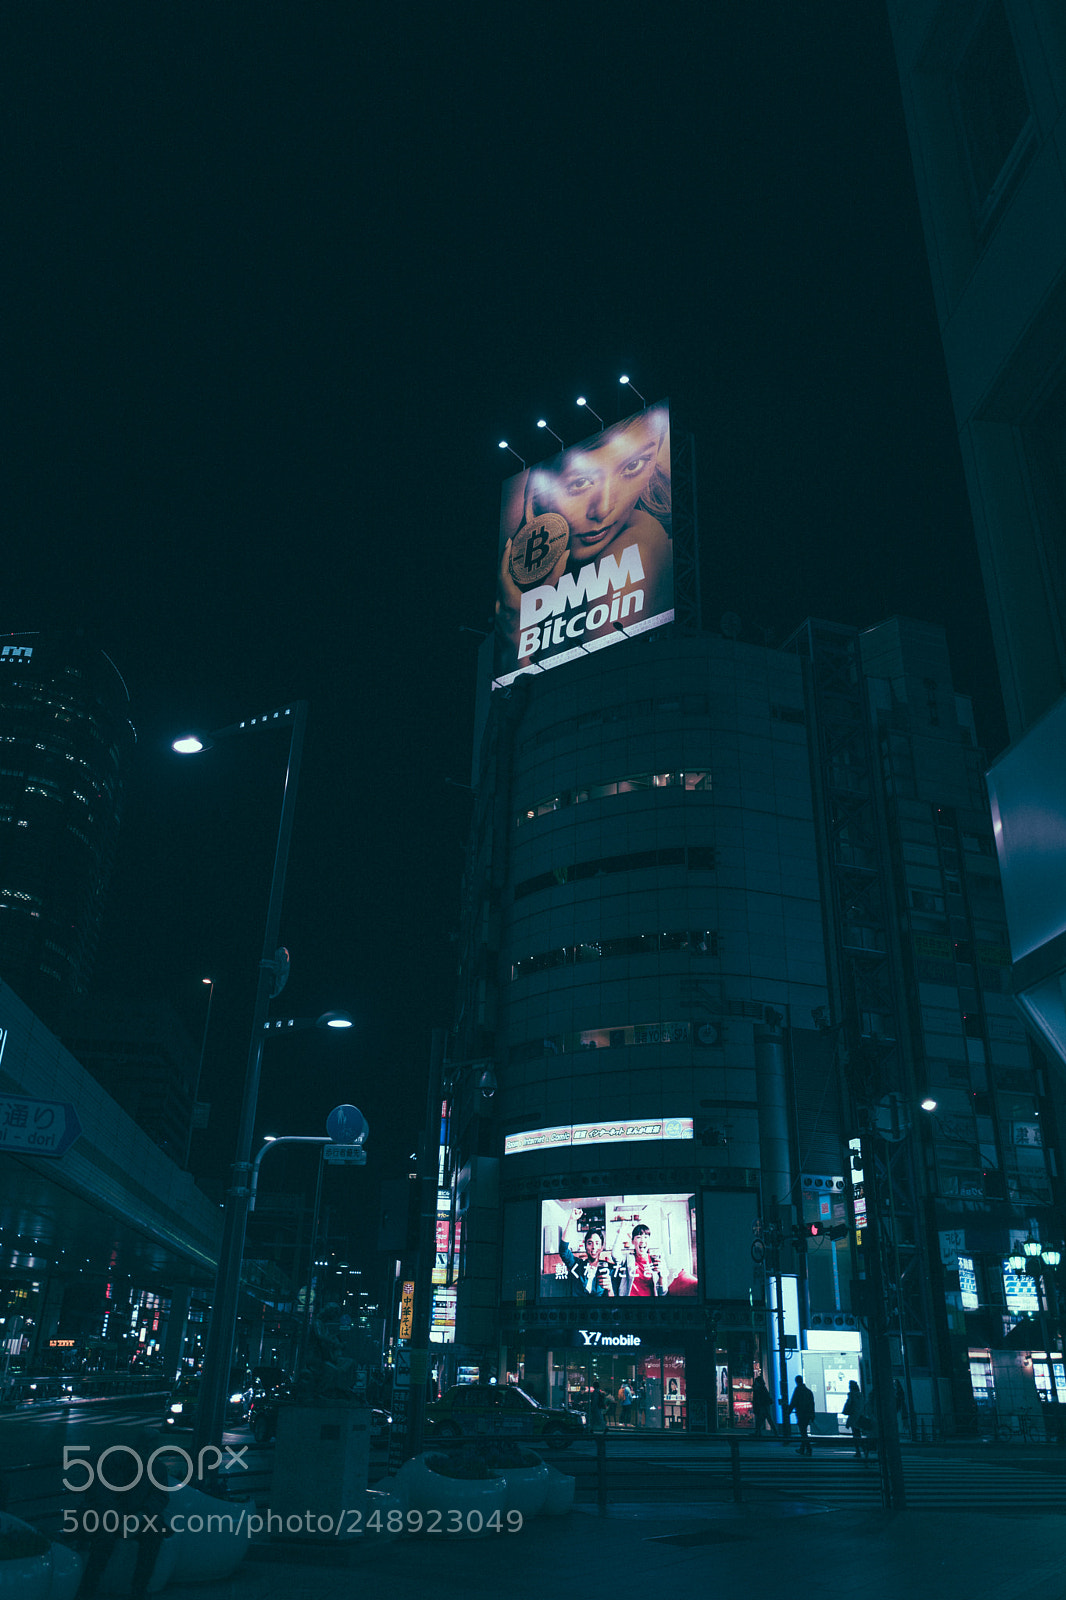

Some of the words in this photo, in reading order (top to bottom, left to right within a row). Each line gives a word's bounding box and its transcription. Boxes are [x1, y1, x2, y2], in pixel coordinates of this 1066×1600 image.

[519, 543, 646, 631] DMM
[517, 588, 645, 660] Bitcoin
[0, 1103, 55, 1130] 通り
[28, 1132, 56, 1146] dori
